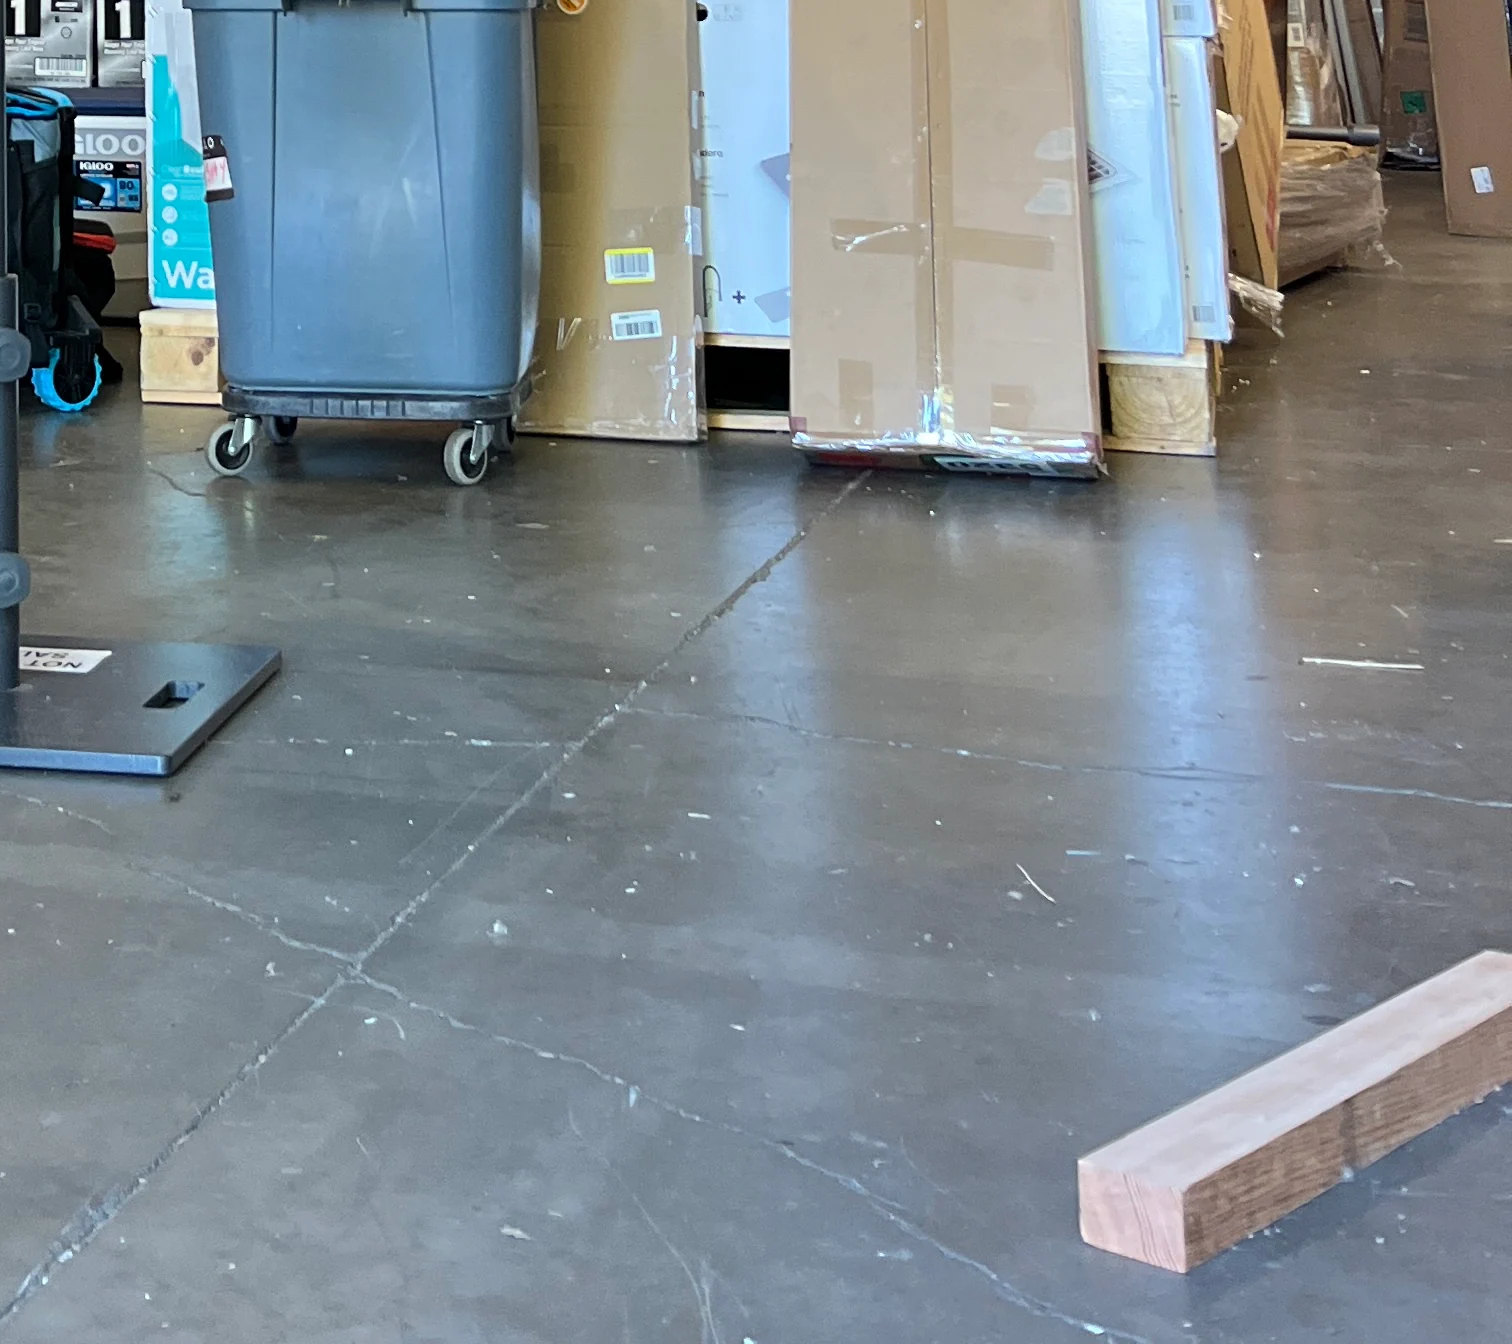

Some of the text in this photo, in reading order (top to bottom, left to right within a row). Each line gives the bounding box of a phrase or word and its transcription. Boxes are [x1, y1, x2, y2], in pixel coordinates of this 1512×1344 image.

[114, 0, 132, 39] 1
[74, 134, 146, 156] GLOO
[79, 161, 114, 172] IGLOO
[28, 660, 83, 670] NOT
